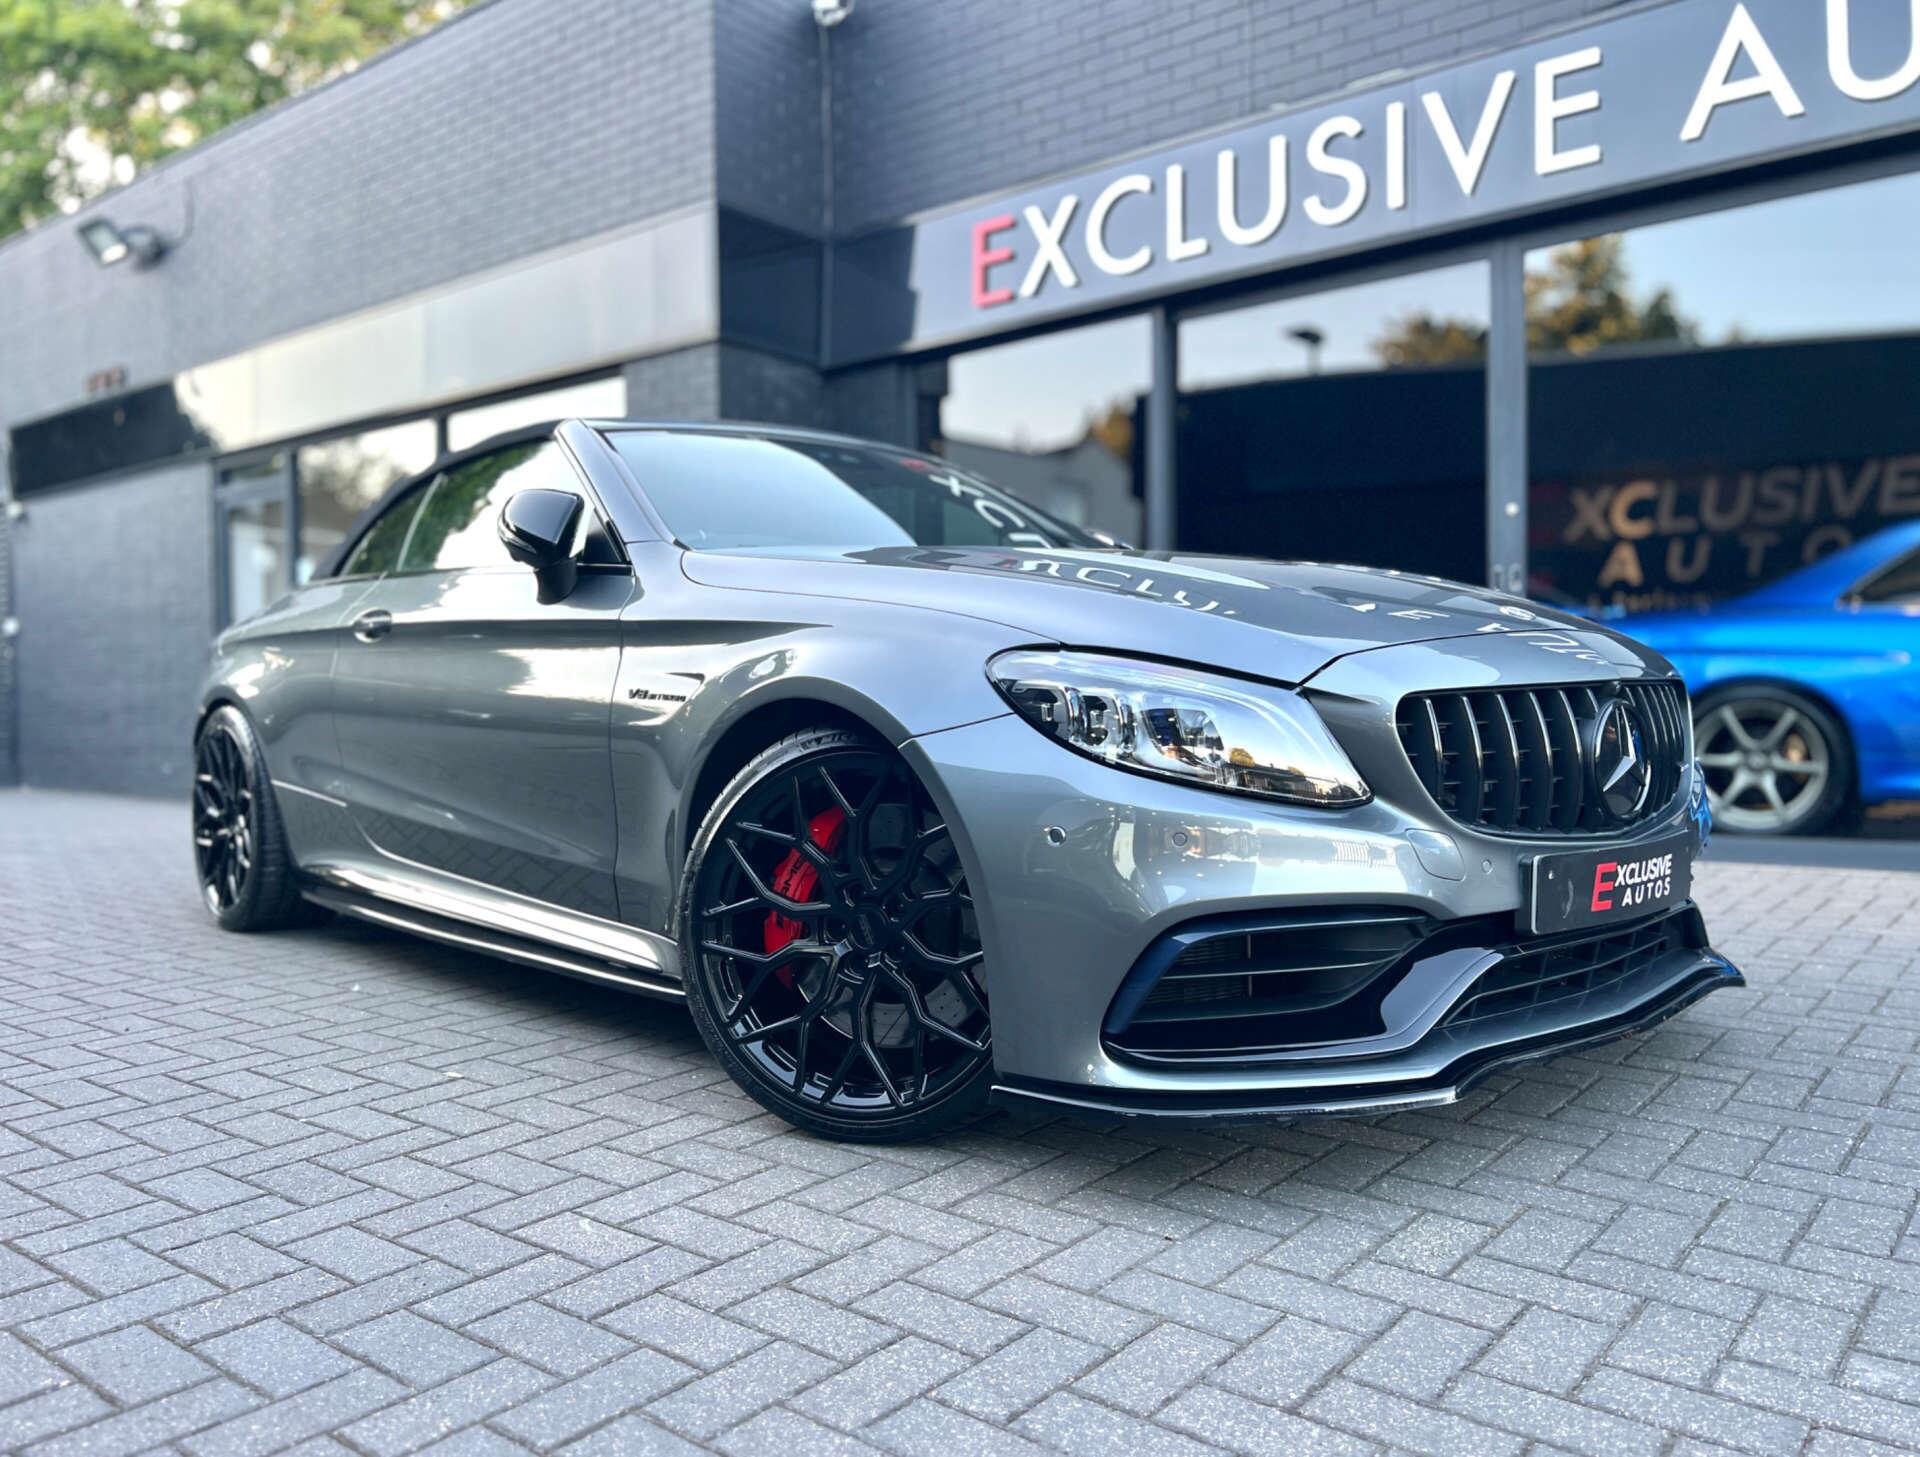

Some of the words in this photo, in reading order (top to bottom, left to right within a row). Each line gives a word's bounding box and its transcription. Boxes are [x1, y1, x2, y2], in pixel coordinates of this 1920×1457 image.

[970, 45, 1602, 308] EXCLUSIVE
[1680, 0, 1920, 142] AU
[1591, 854, 1673, 912] EXCLUSIVE
[1622, 876, 1671, 907] AUTOS
